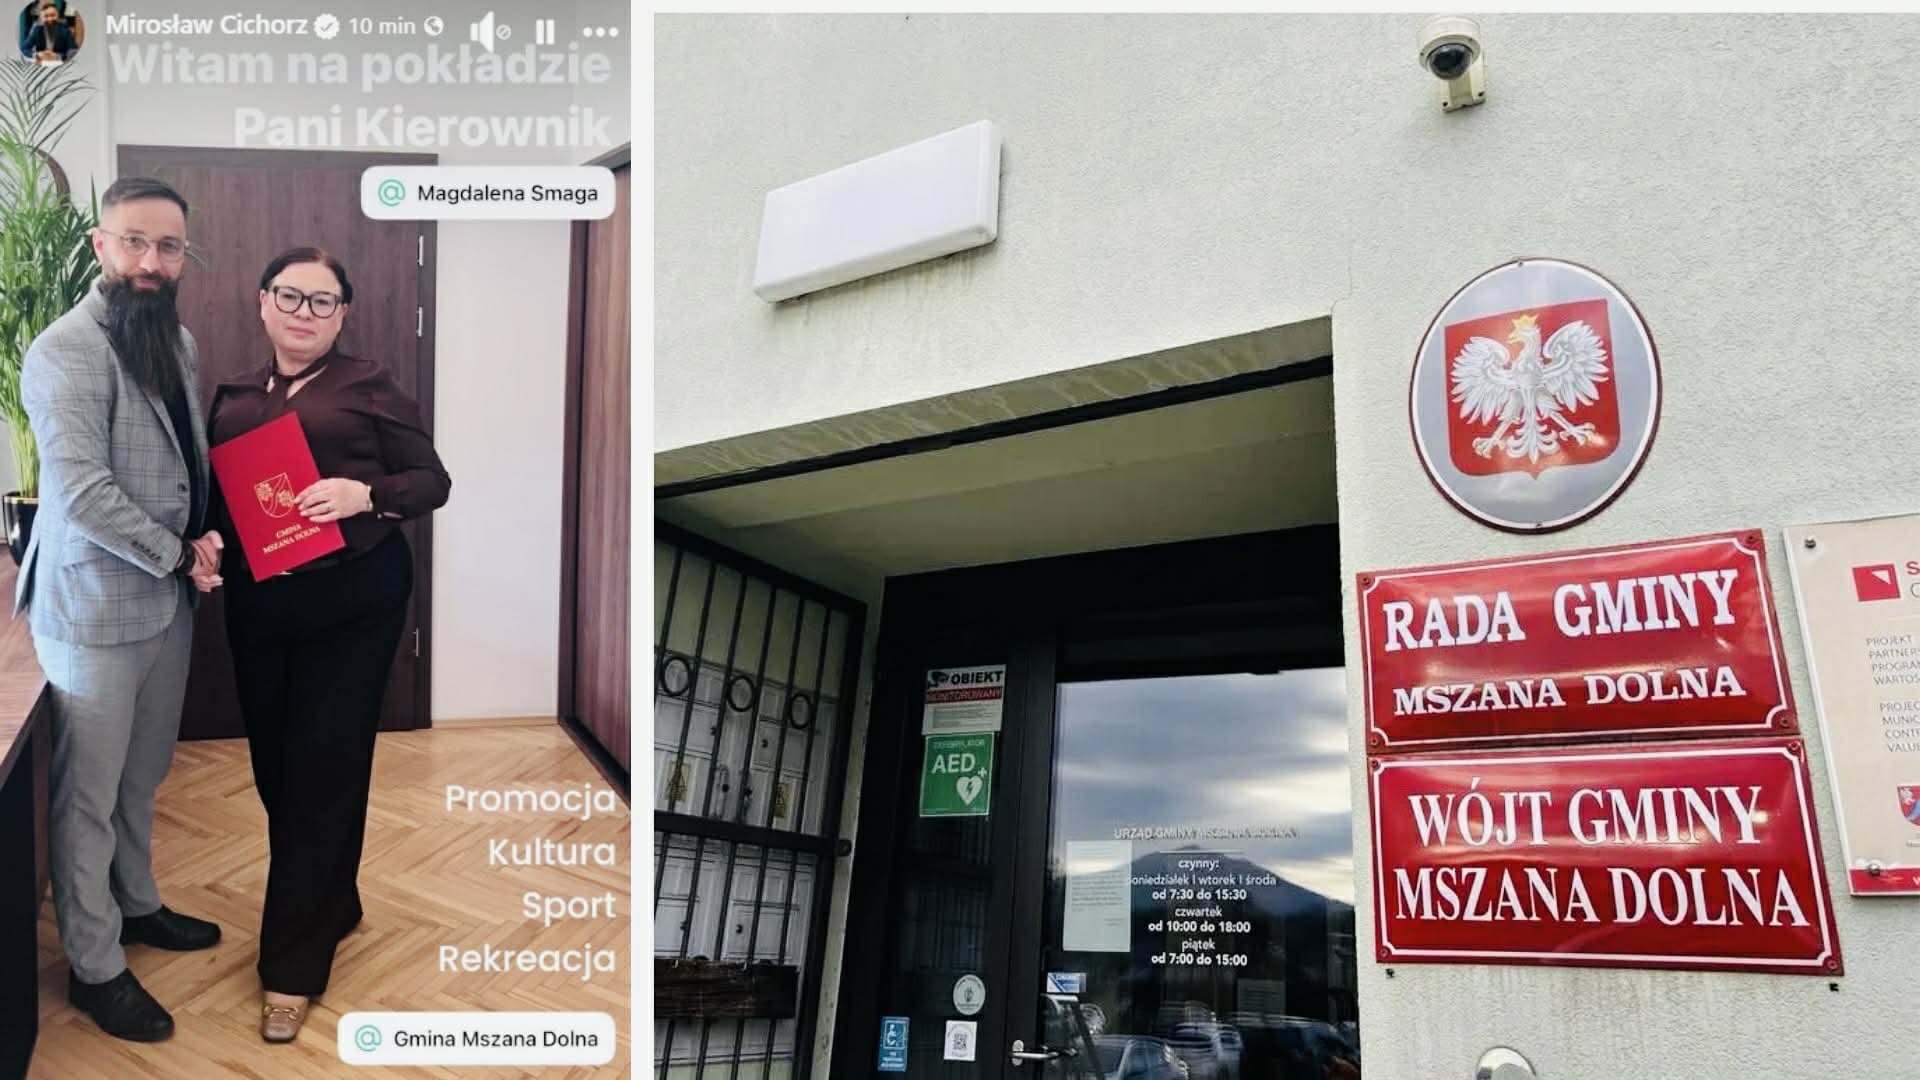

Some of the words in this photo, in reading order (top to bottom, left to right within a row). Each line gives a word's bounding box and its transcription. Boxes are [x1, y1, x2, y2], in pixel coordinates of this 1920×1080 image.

[1383, 591, 1526, 652] RADA
[1554, 569, 1738, 638] GMINY
[951, 670, 1004, 685] OBIEKT
[1394, 678, 1566, 717] MSZANA
[1586, 665, 1746, 705] DOLNA
[931, 753, 976, 774] AED
[1408, 777, 1551, 847] WÓJT
[1568, 785, 1762, 845] GMINY
[1178, 860, 1220, 871] czynny:
[1198, 874, 1236, 885] wtorek
[1246, 873, 1276, 886] środa
[1152, 888, 1167, 900] od
[1169, 889, 1194, 900] 7:30
[1196, 888, 1212, 900] do
[1215, 889, 1247, 900] 15:30
[1394, 867, 1600, 923] MSZANA
[1609, 867, 1811, 927] DOLNA
[1175, 905, 1222, 917] czwartek
[1148, 920, 1163, 932] od
[1167, 921, 1197, 932] 10:00
[1200, 921, 1215, 932] do
[1219, 921, 1251, 933] 18:00
[1182, 938, 1215, 952] piątek
[1151, 952, 1166, 964] od
[1169, 953, 1194, 964] 7:00
[1196, 953, 1212, 965] do
[1216, 954, 1247, 966] 15:00
